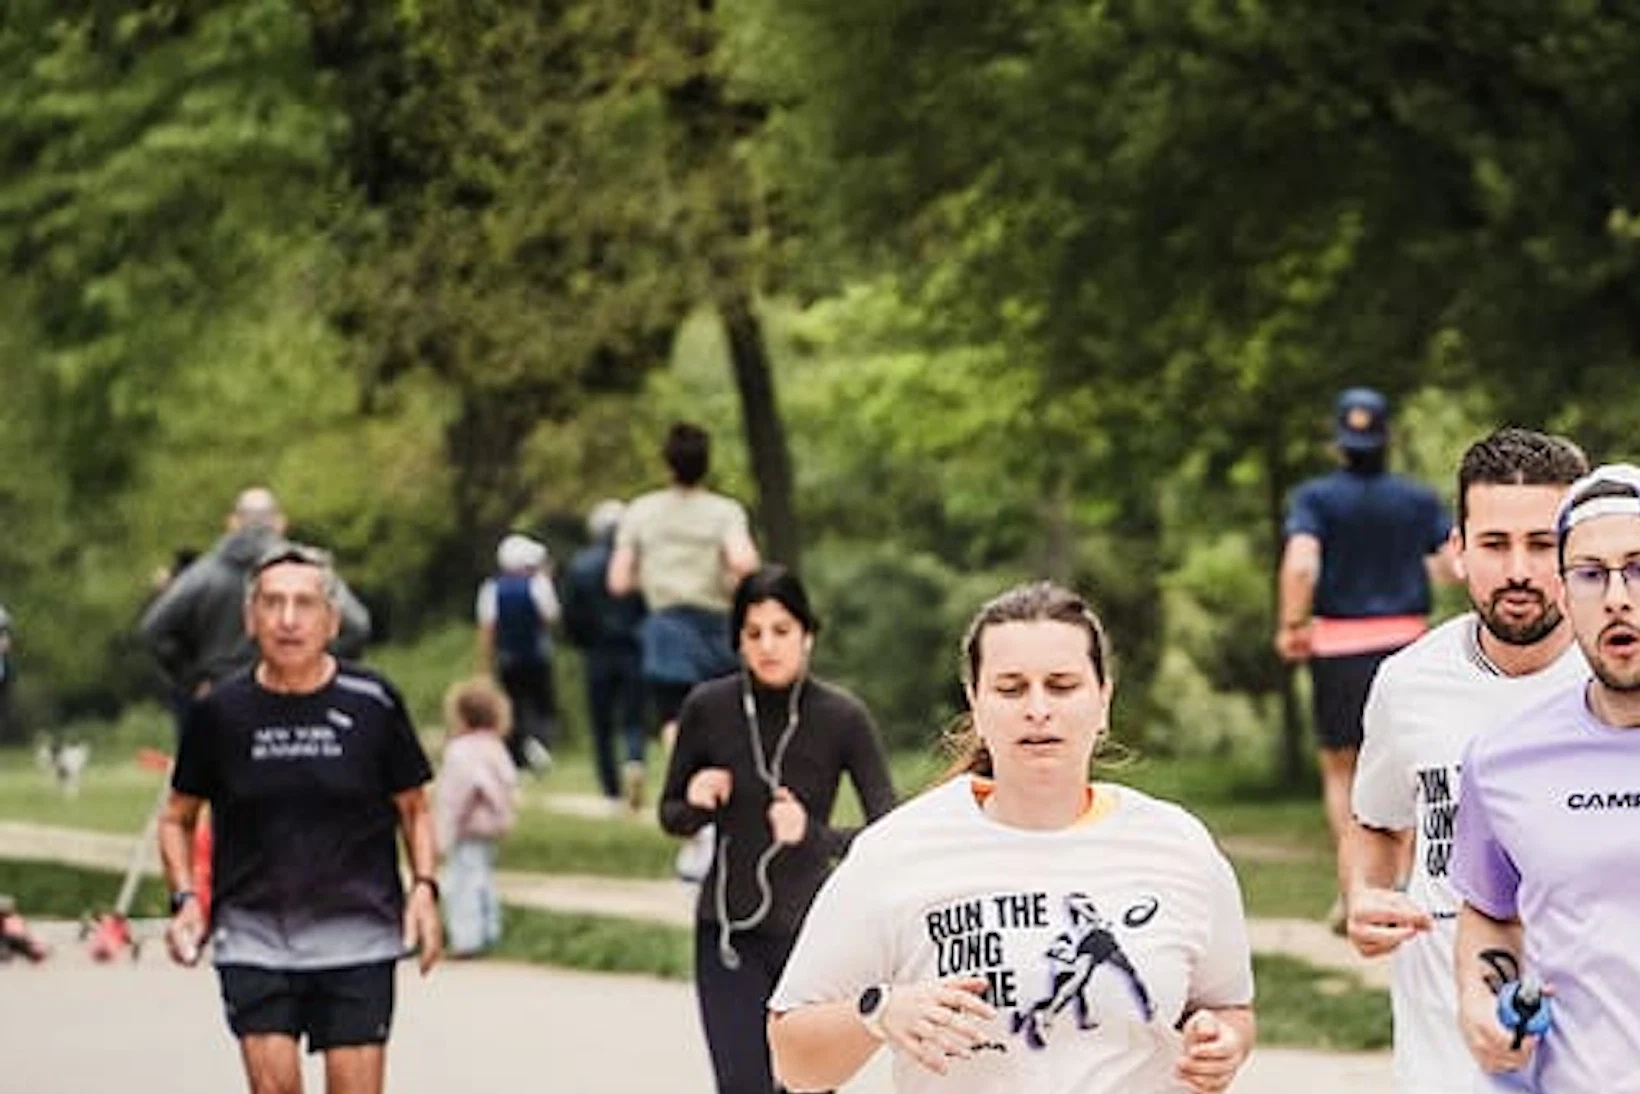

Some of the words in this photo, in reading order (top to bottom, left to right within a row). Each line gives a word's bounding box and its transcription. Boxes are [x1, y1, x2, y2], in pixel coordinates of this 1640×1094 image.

[927, 900, 983, 941] RUN
[994, 893, 1049, 929] THE
[937, 932, 1003, 977] LONG
